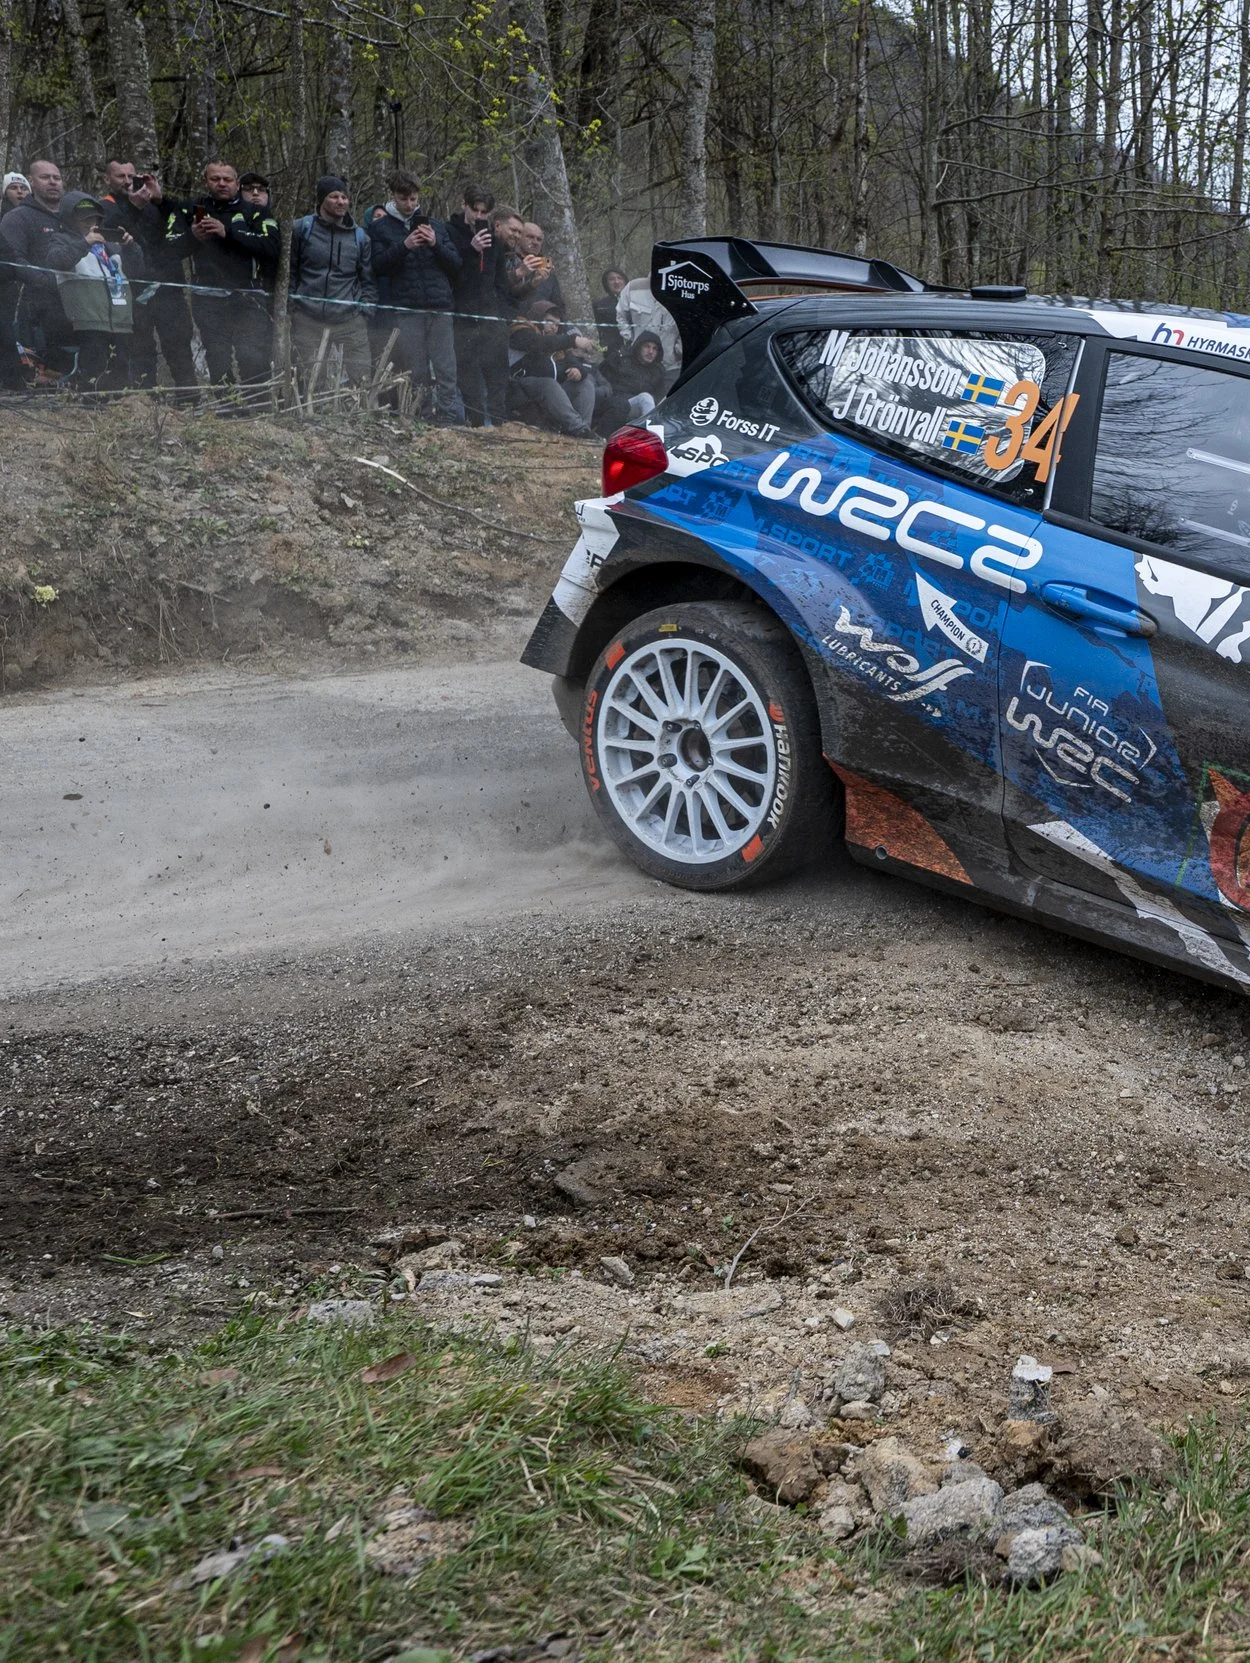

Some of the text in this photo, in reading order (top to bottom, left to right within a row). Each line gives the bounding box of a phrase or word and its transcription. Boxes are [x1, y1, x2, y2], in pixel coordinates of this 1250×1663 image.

[667, 274, 710, 294] Sjötorps
[681, 289, 695, 299] Hus
[819, 329, 963, 398] M Johansson
[717, 410, 781, 442] Forss IT
[833, 384, 951, 445] J Grönvall
[983, 380, 1081, 483] 34
[758, 451, 1043, 593] WRC2
[930, 599, 966, 642] CHAMPION
[821, 635, 902, 692] LUBRICANTS
[1026, 685, 1140, 765] JUNIOR
[1074, 686, 1109, 716] FIA
[1005, 696, 1140, 803] WRC
